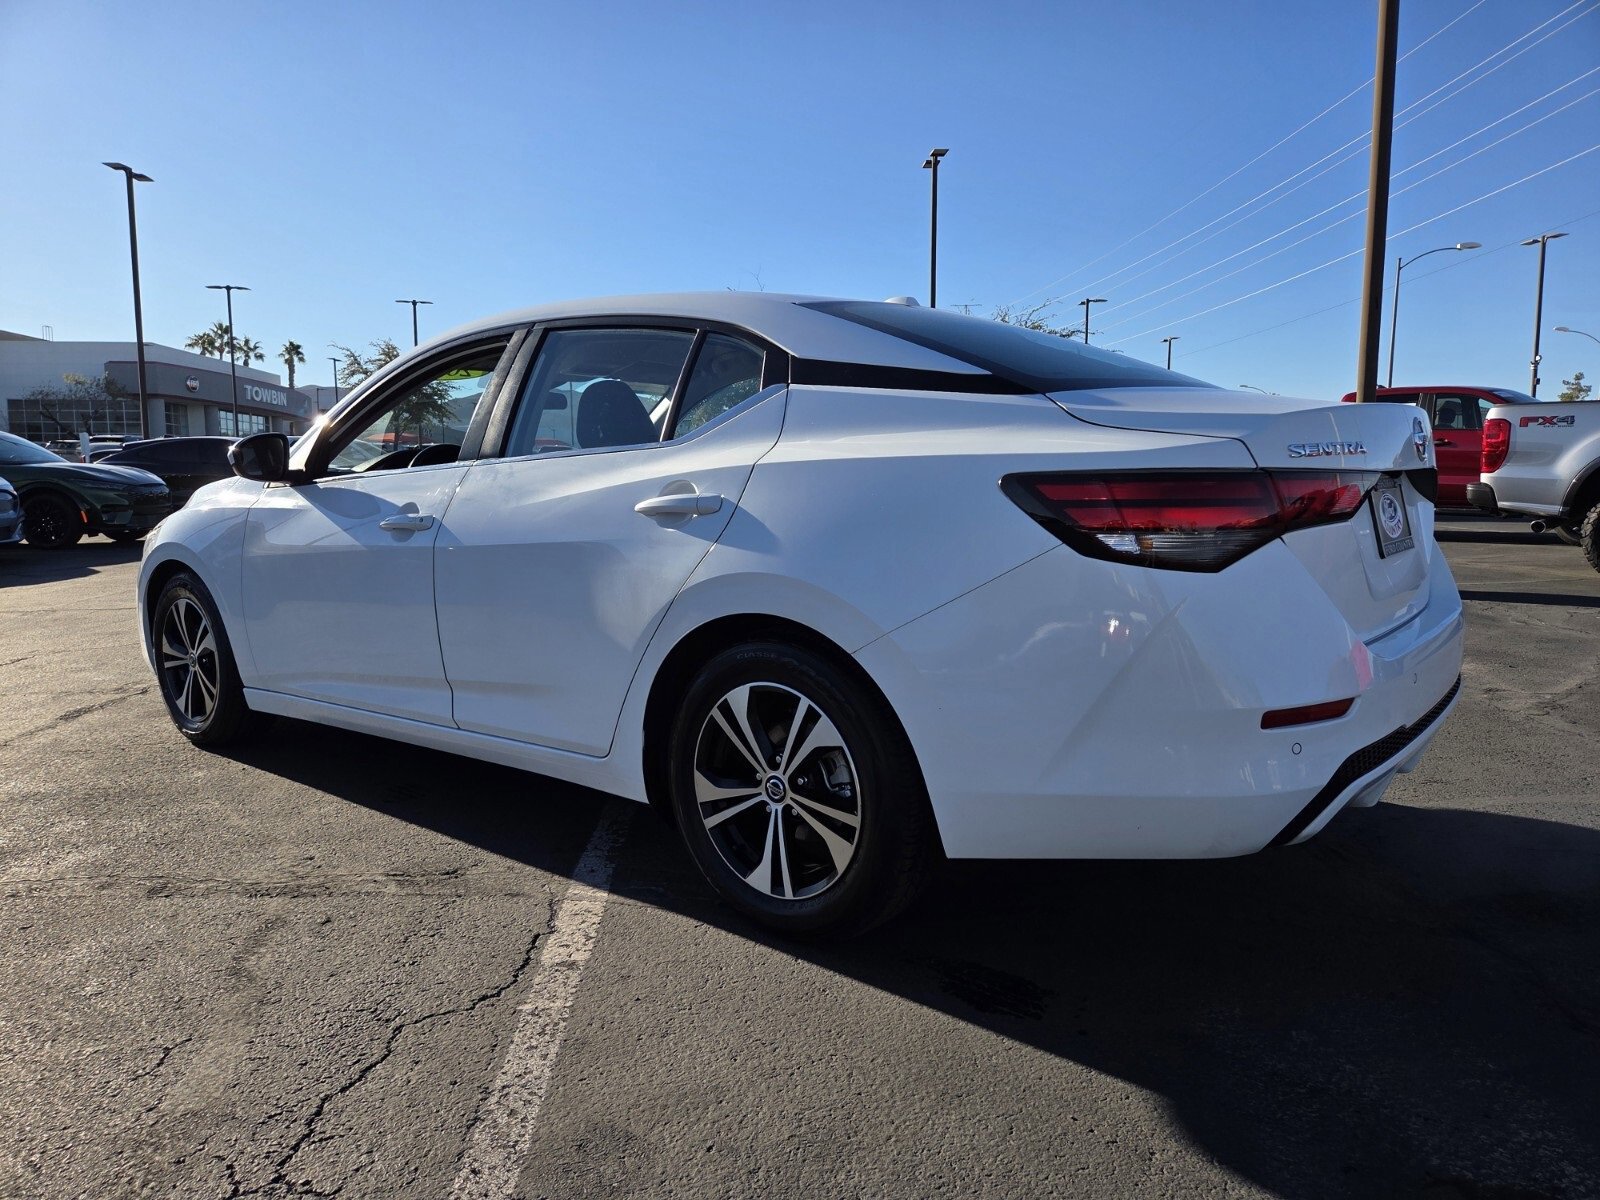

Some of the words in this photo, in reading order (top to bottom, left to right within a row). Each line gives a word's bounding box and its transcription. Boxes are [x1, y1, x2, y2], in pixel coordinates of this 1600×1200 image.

[243, 384, 288, 407] TOWBIN
[1519, 415, 1576, 428] FX4
[1287, 441, 1369, 458] SENTRA
